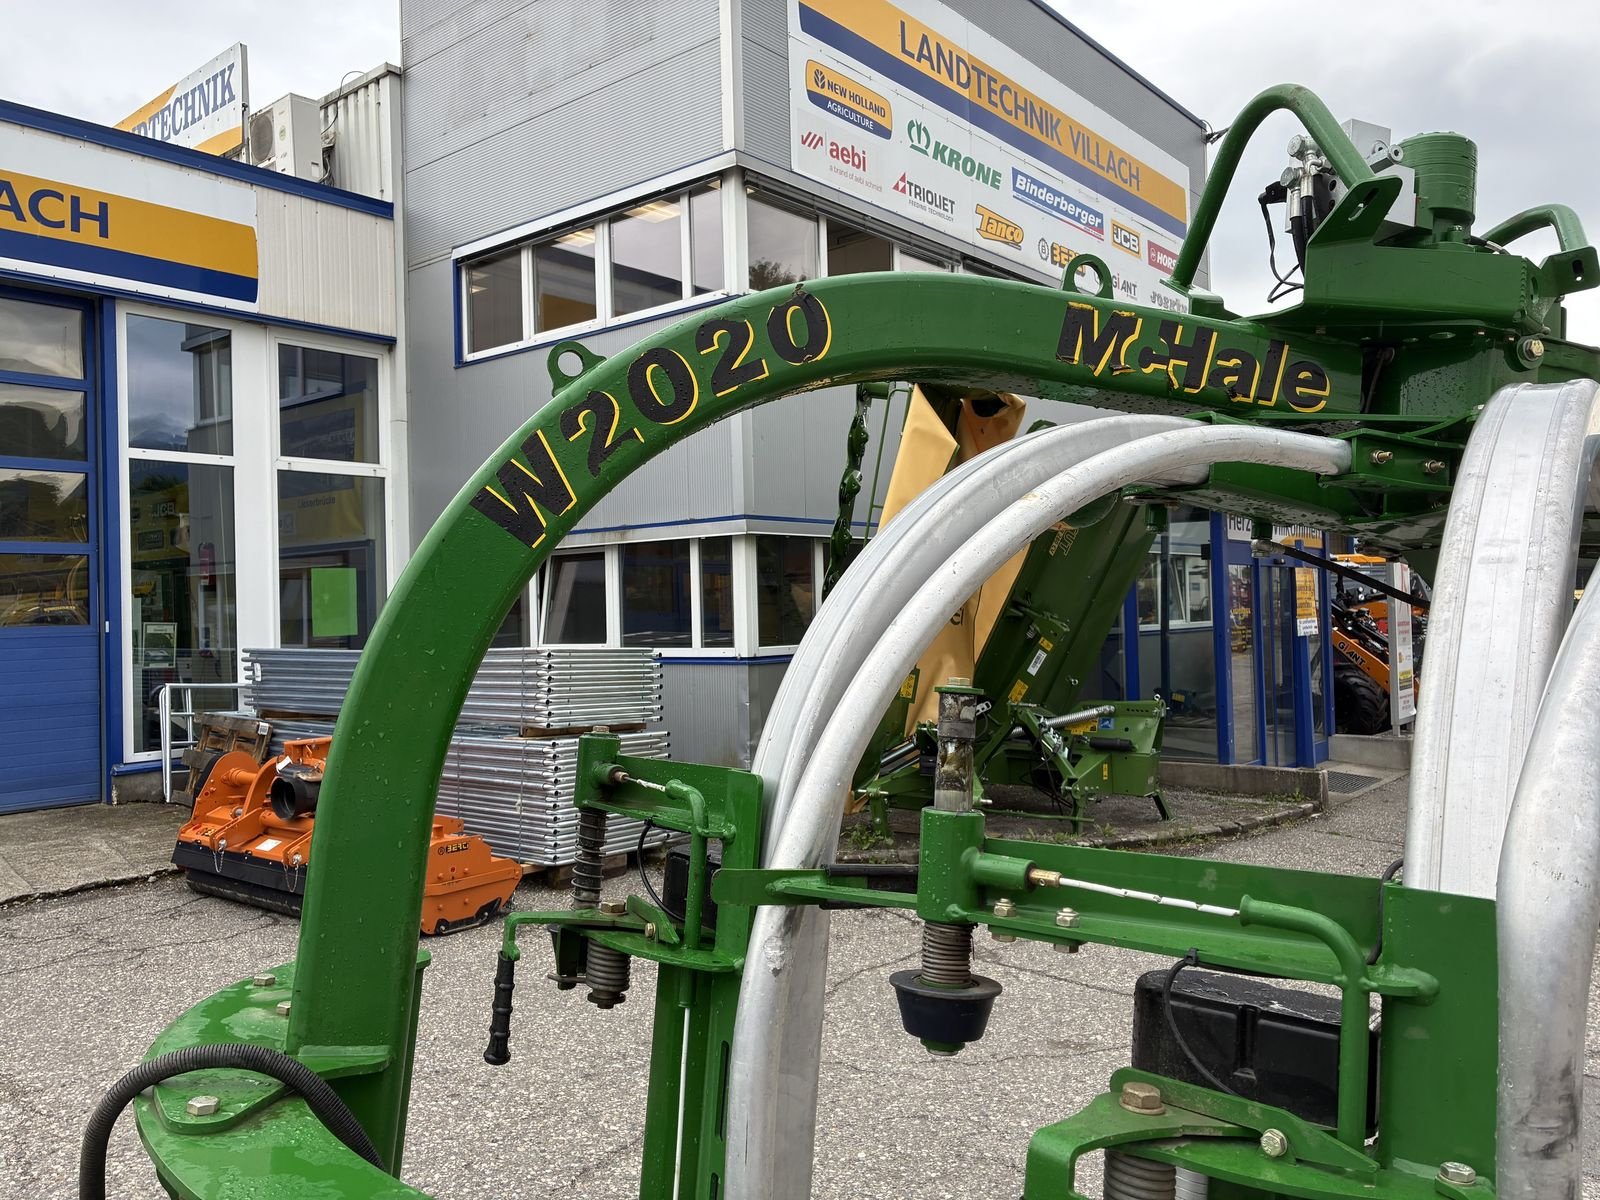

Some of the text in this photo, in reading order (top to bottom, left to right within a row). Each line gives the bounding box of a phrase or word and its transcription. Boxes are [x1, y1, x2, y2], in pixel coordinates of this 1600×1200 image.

[827, 80, 886, 118] NEW HOLLAND
[827, 101, 874, 130] AGRICULTURE
[900, 20, 1141, 192] LANDTECHNIK VILLACH
[829, 141, 867, 172] aebi
[932, 141, 1002, 190] KRONE
[0, 180, 109, 239] ACH
[907, 181, 956, 215] TRIOLIET
[1016, 174, 1102, 228] Binderberger
[975, 204, 1024, 245] Tanco
[1113, 227, 1139, 253] JCB
[1157, 251, 1177, 268] HORS
[1056, 301, 1331, 413] McHale
[469, 289, 833, 549] W2020
